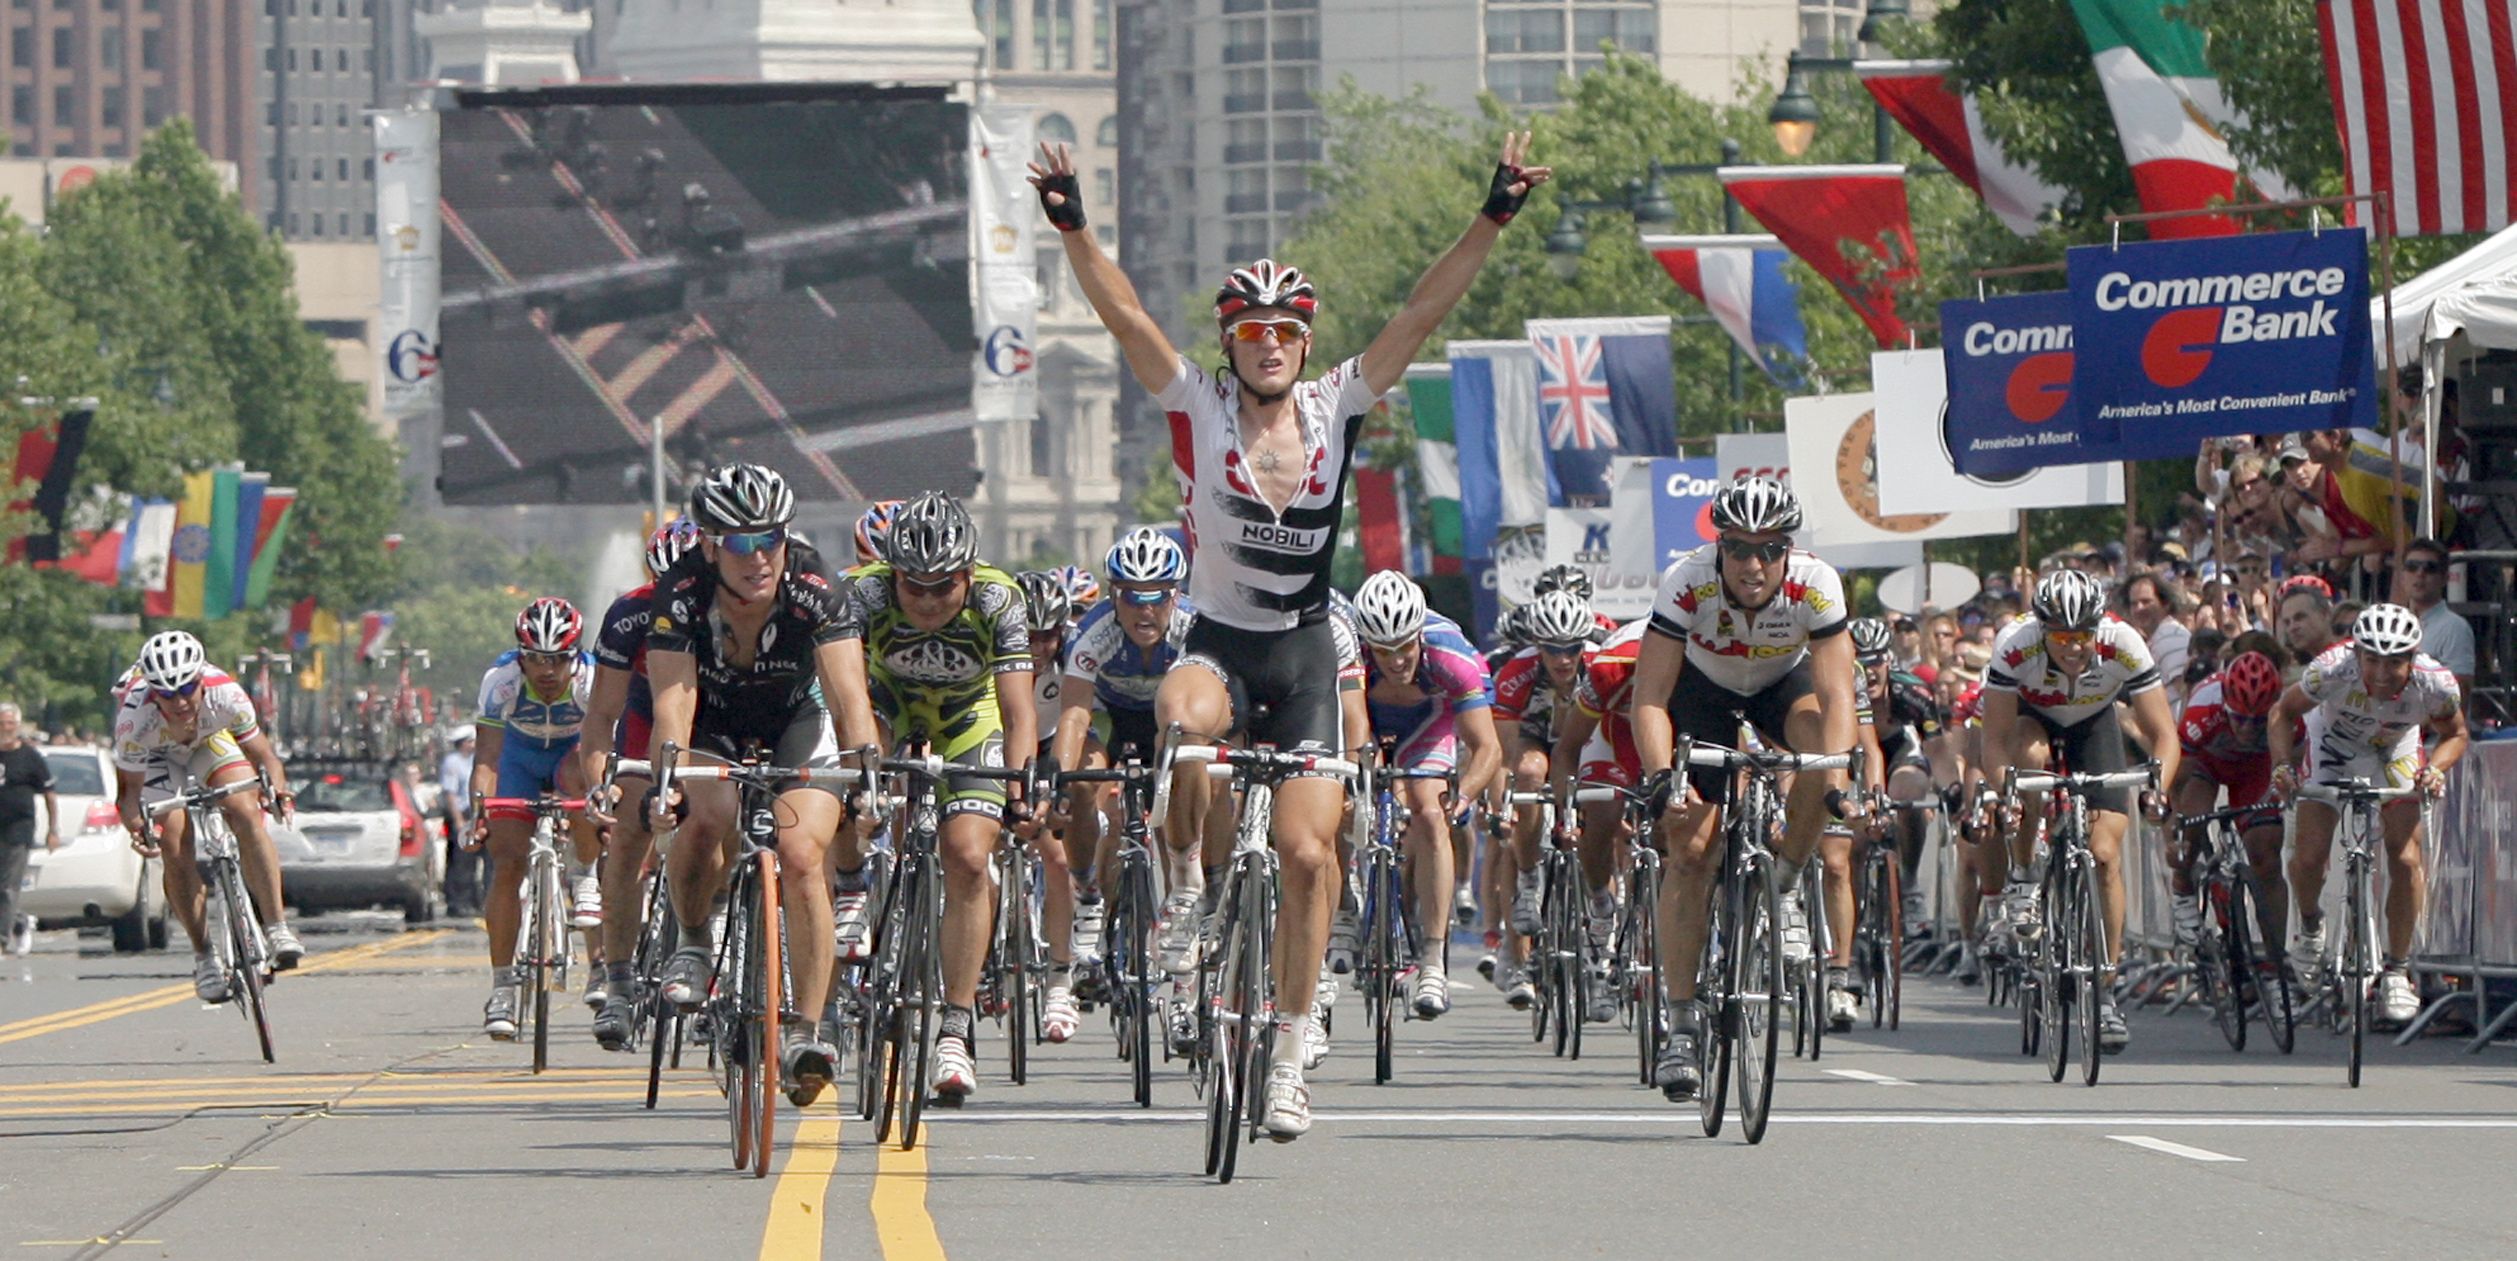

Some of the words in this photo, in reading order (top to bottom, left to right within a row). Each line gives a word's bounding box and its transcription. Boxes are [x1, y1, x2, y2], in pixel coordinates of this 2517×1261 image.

[2094, 266, 2346, 312] Commerce
[2220, 299, 2340, 345] Bank
[2098, 401, 2174, 420] America's
[2176, 398, 2218, 415] Most
[2219, 392, 2307, 412] Convenient
[1969, 433, 2036, 452] America's
[2038, 431, 2073, 446] Most
[1242, 523, 1315, 549] NOBILI
